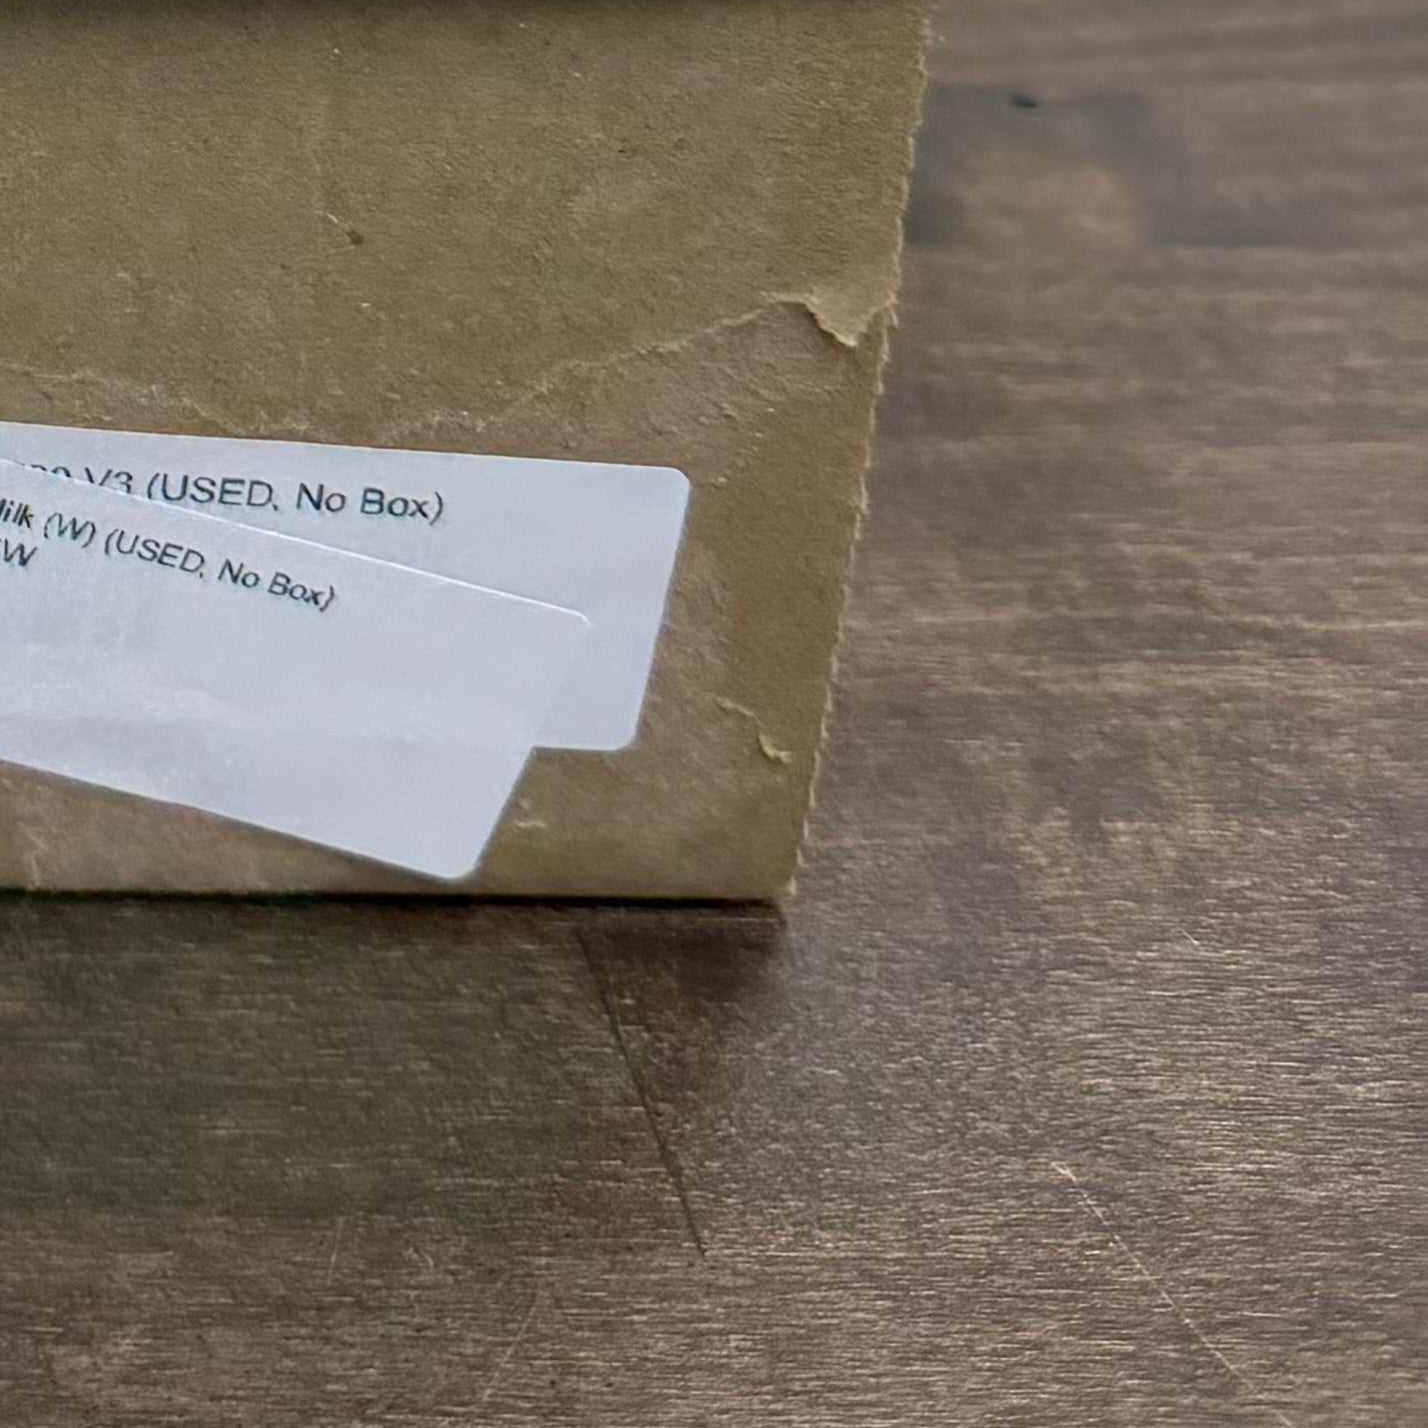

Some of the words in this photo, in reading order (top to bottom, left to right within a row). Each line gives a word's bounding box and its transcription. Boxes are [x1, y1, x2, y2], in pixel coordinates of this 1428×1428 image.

[295, 482, 347, 513] No
[359, 487, 444, 526] Box)
[43, 512, 97, 548] (W)
[217, 558, 261, 588] No
[267, 571, 336, 612] Box)
